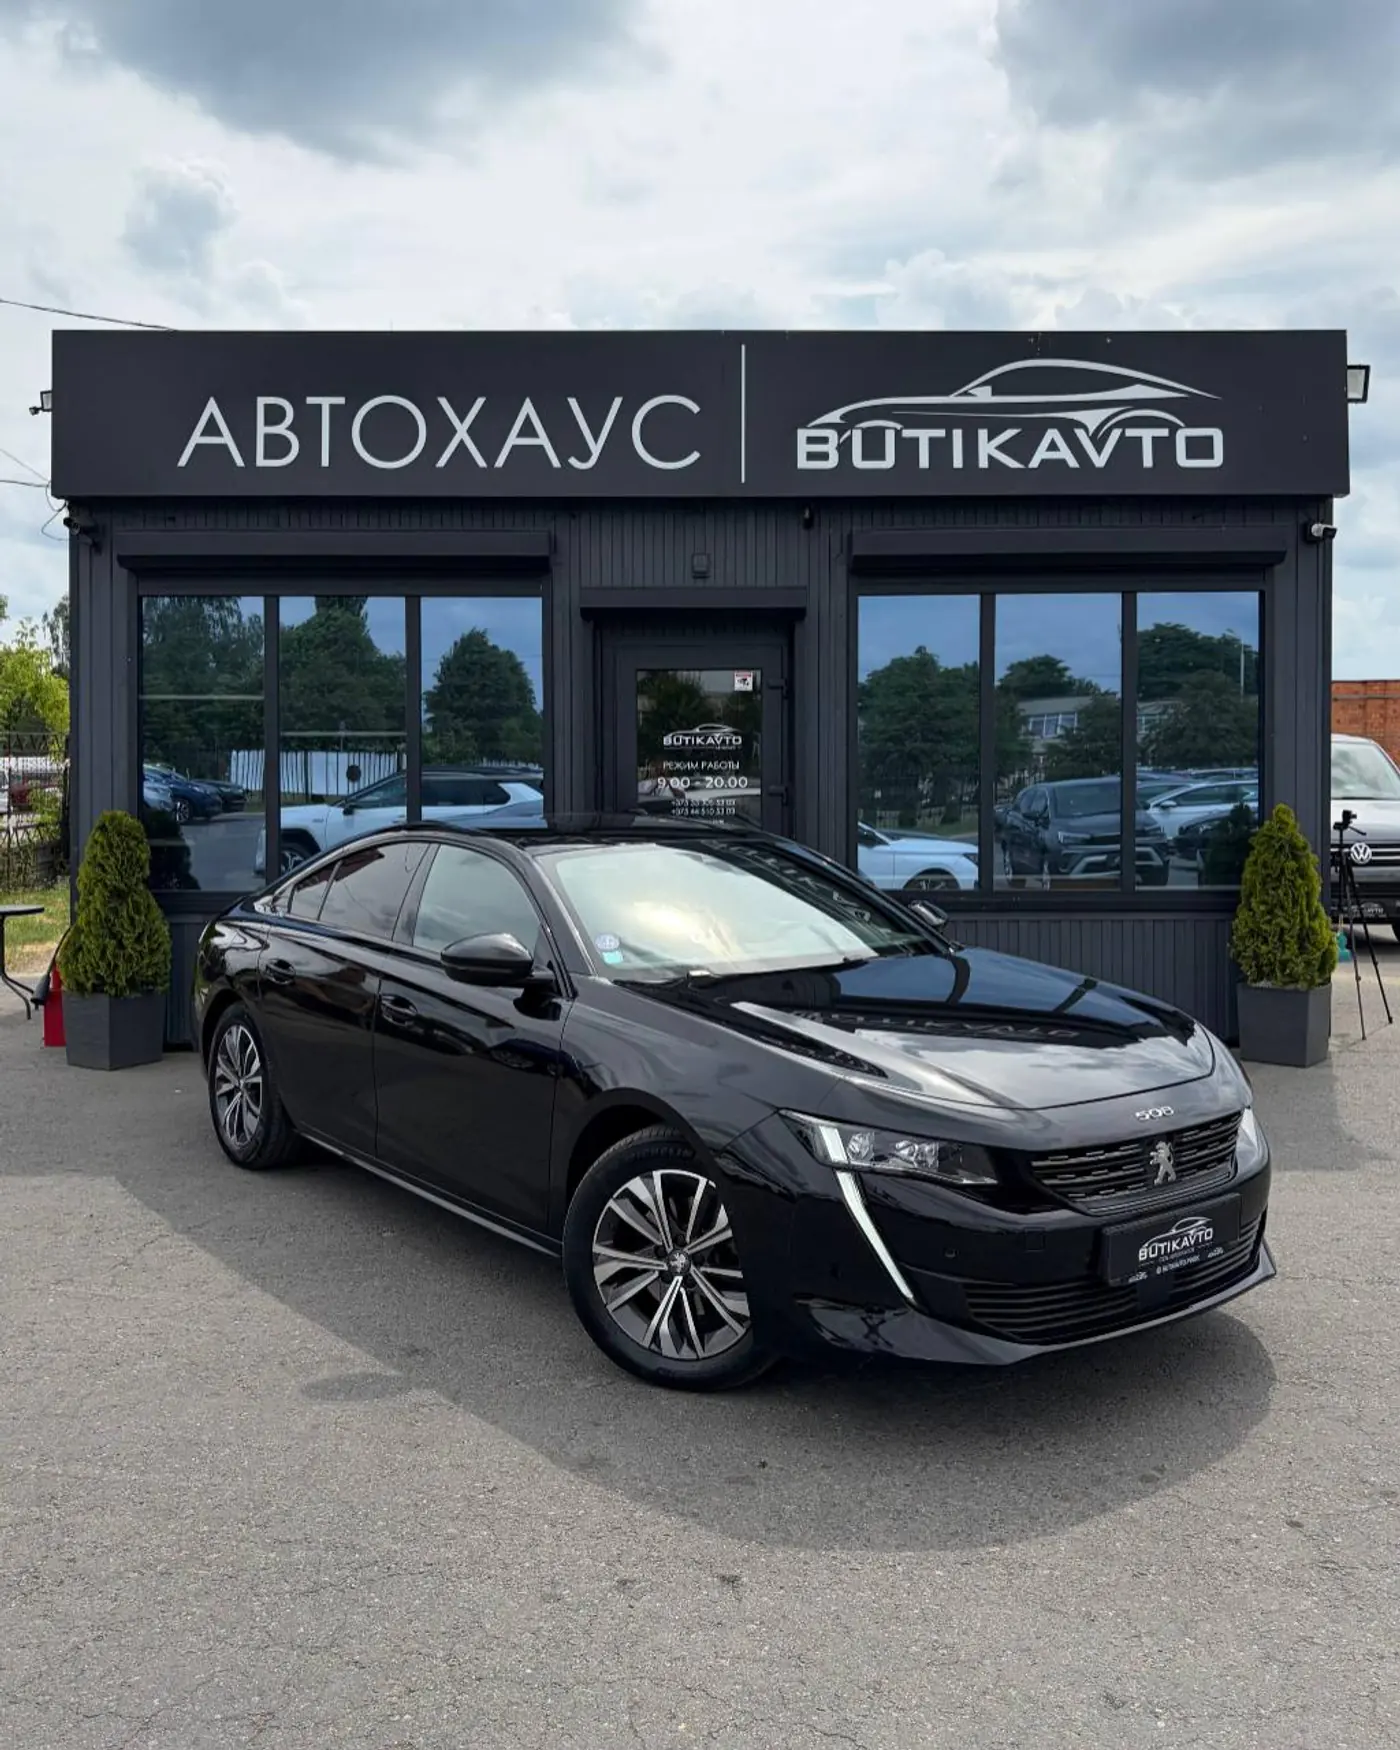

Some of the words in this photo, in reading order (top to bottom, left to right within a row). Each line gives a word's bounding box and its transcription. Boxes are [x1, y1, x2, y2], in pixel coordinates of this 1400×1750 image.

[177, 394, 701, 470] АВТОХАУС
[796, 427, 1224, 470] BUTIKAVTO
[663, 735, 742, 746] BUTIKAVTO
[663, 761, 699, 771] РЕЖИМ
[701, 761, 740, 771] РАБОТЫ
[705, 776, 748, 789] 20.00
[1135, 1106, 1174, 1120] 508
[1138, 1227, 1214, 1261] BUTIKAVTO
